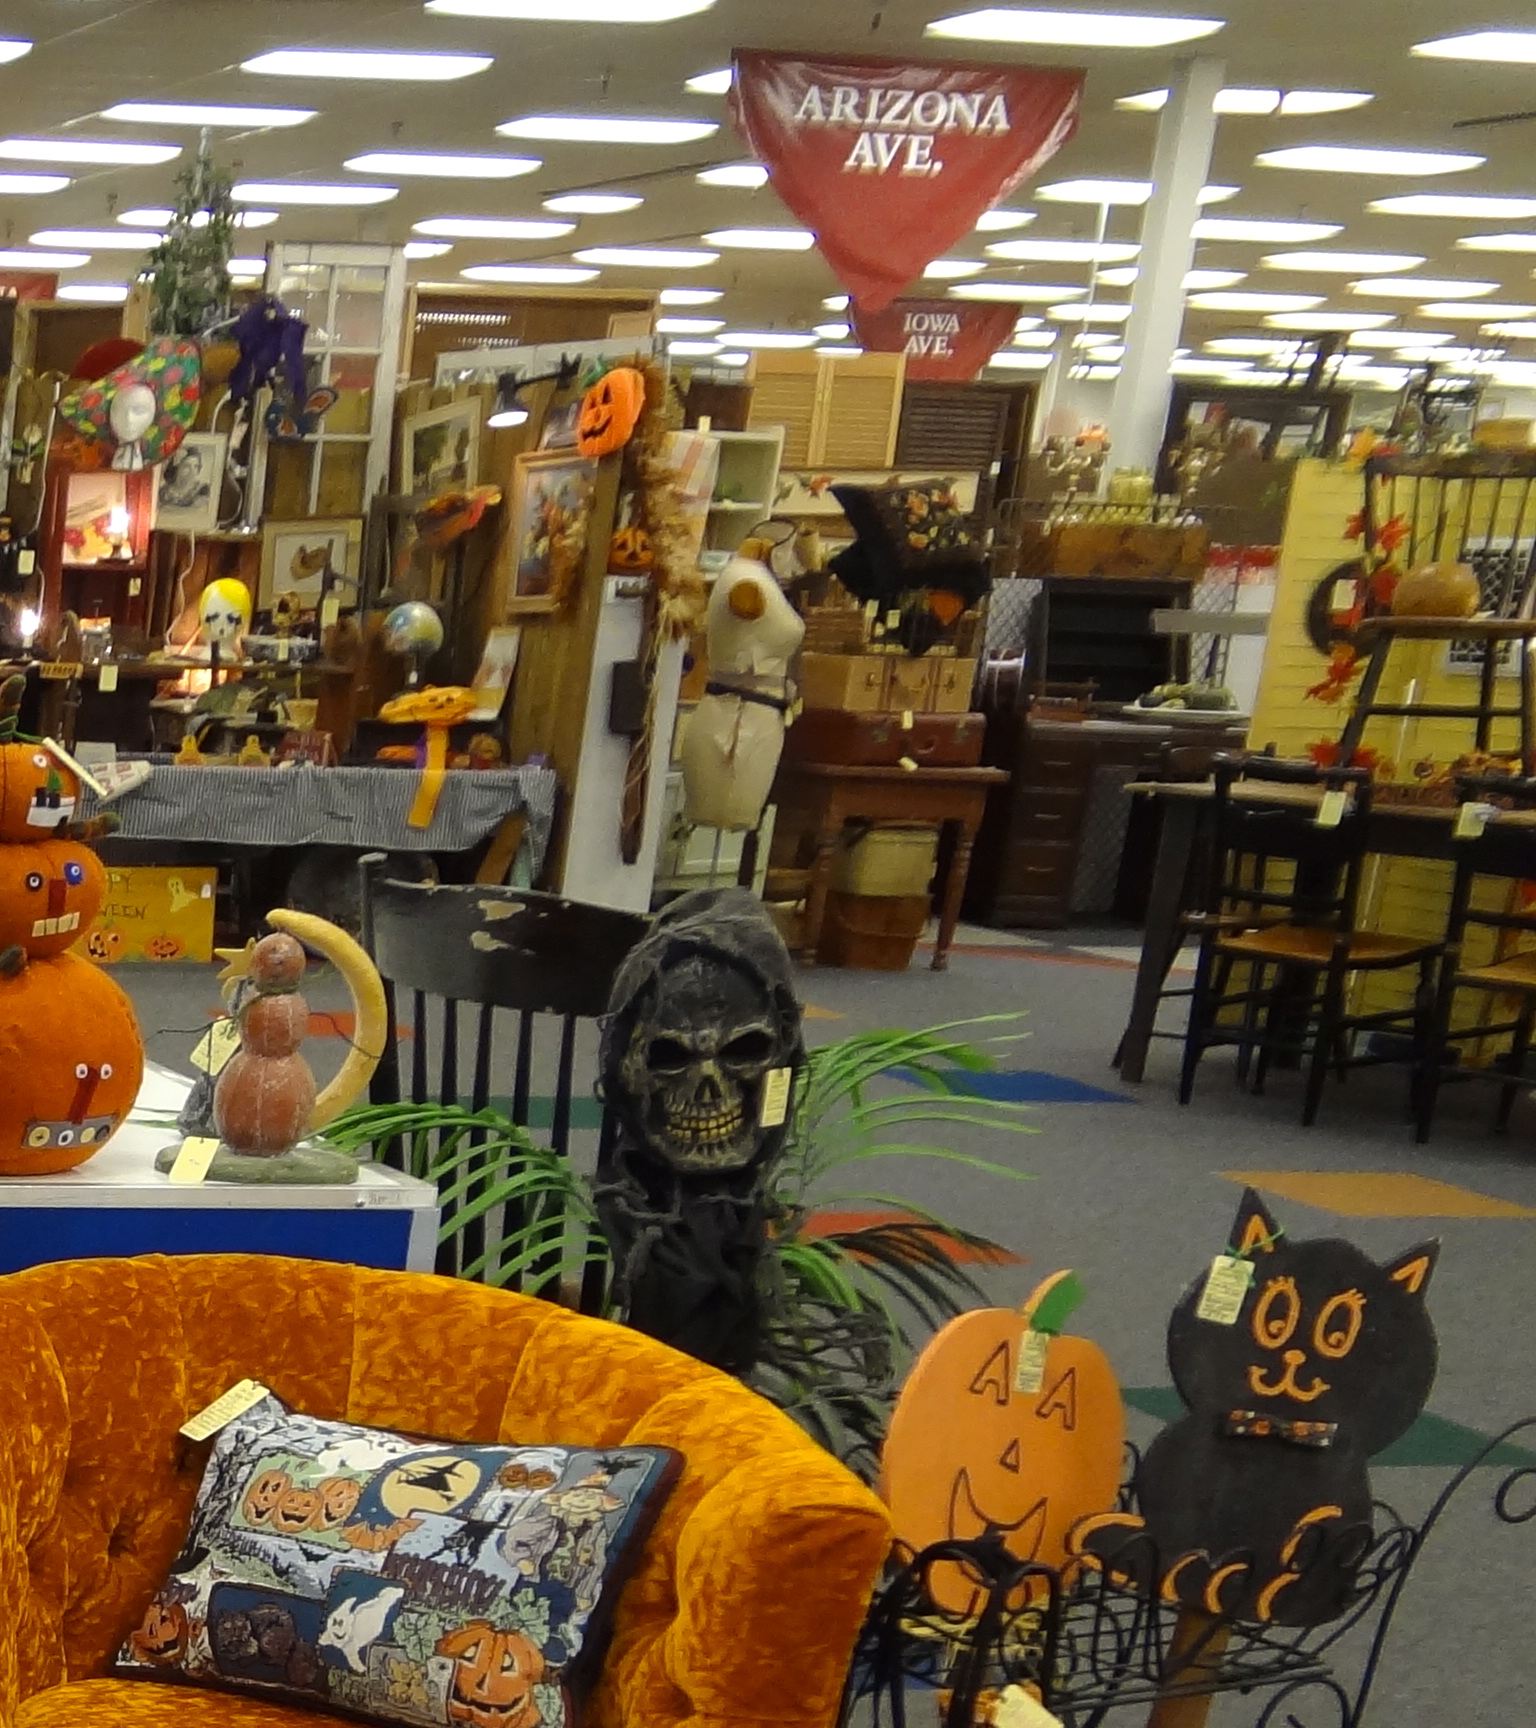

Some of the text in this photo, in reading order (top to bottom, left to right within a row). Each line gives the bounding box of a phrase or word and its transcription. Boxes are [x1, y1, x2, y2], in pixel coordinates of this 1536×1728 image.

[795, 85, 1011, 135] ARIZONA
[842, 132, 944, 176] AVE.
[903, 312, 961, 334] IOWA
[903, 335, 955, 358] AVE.
